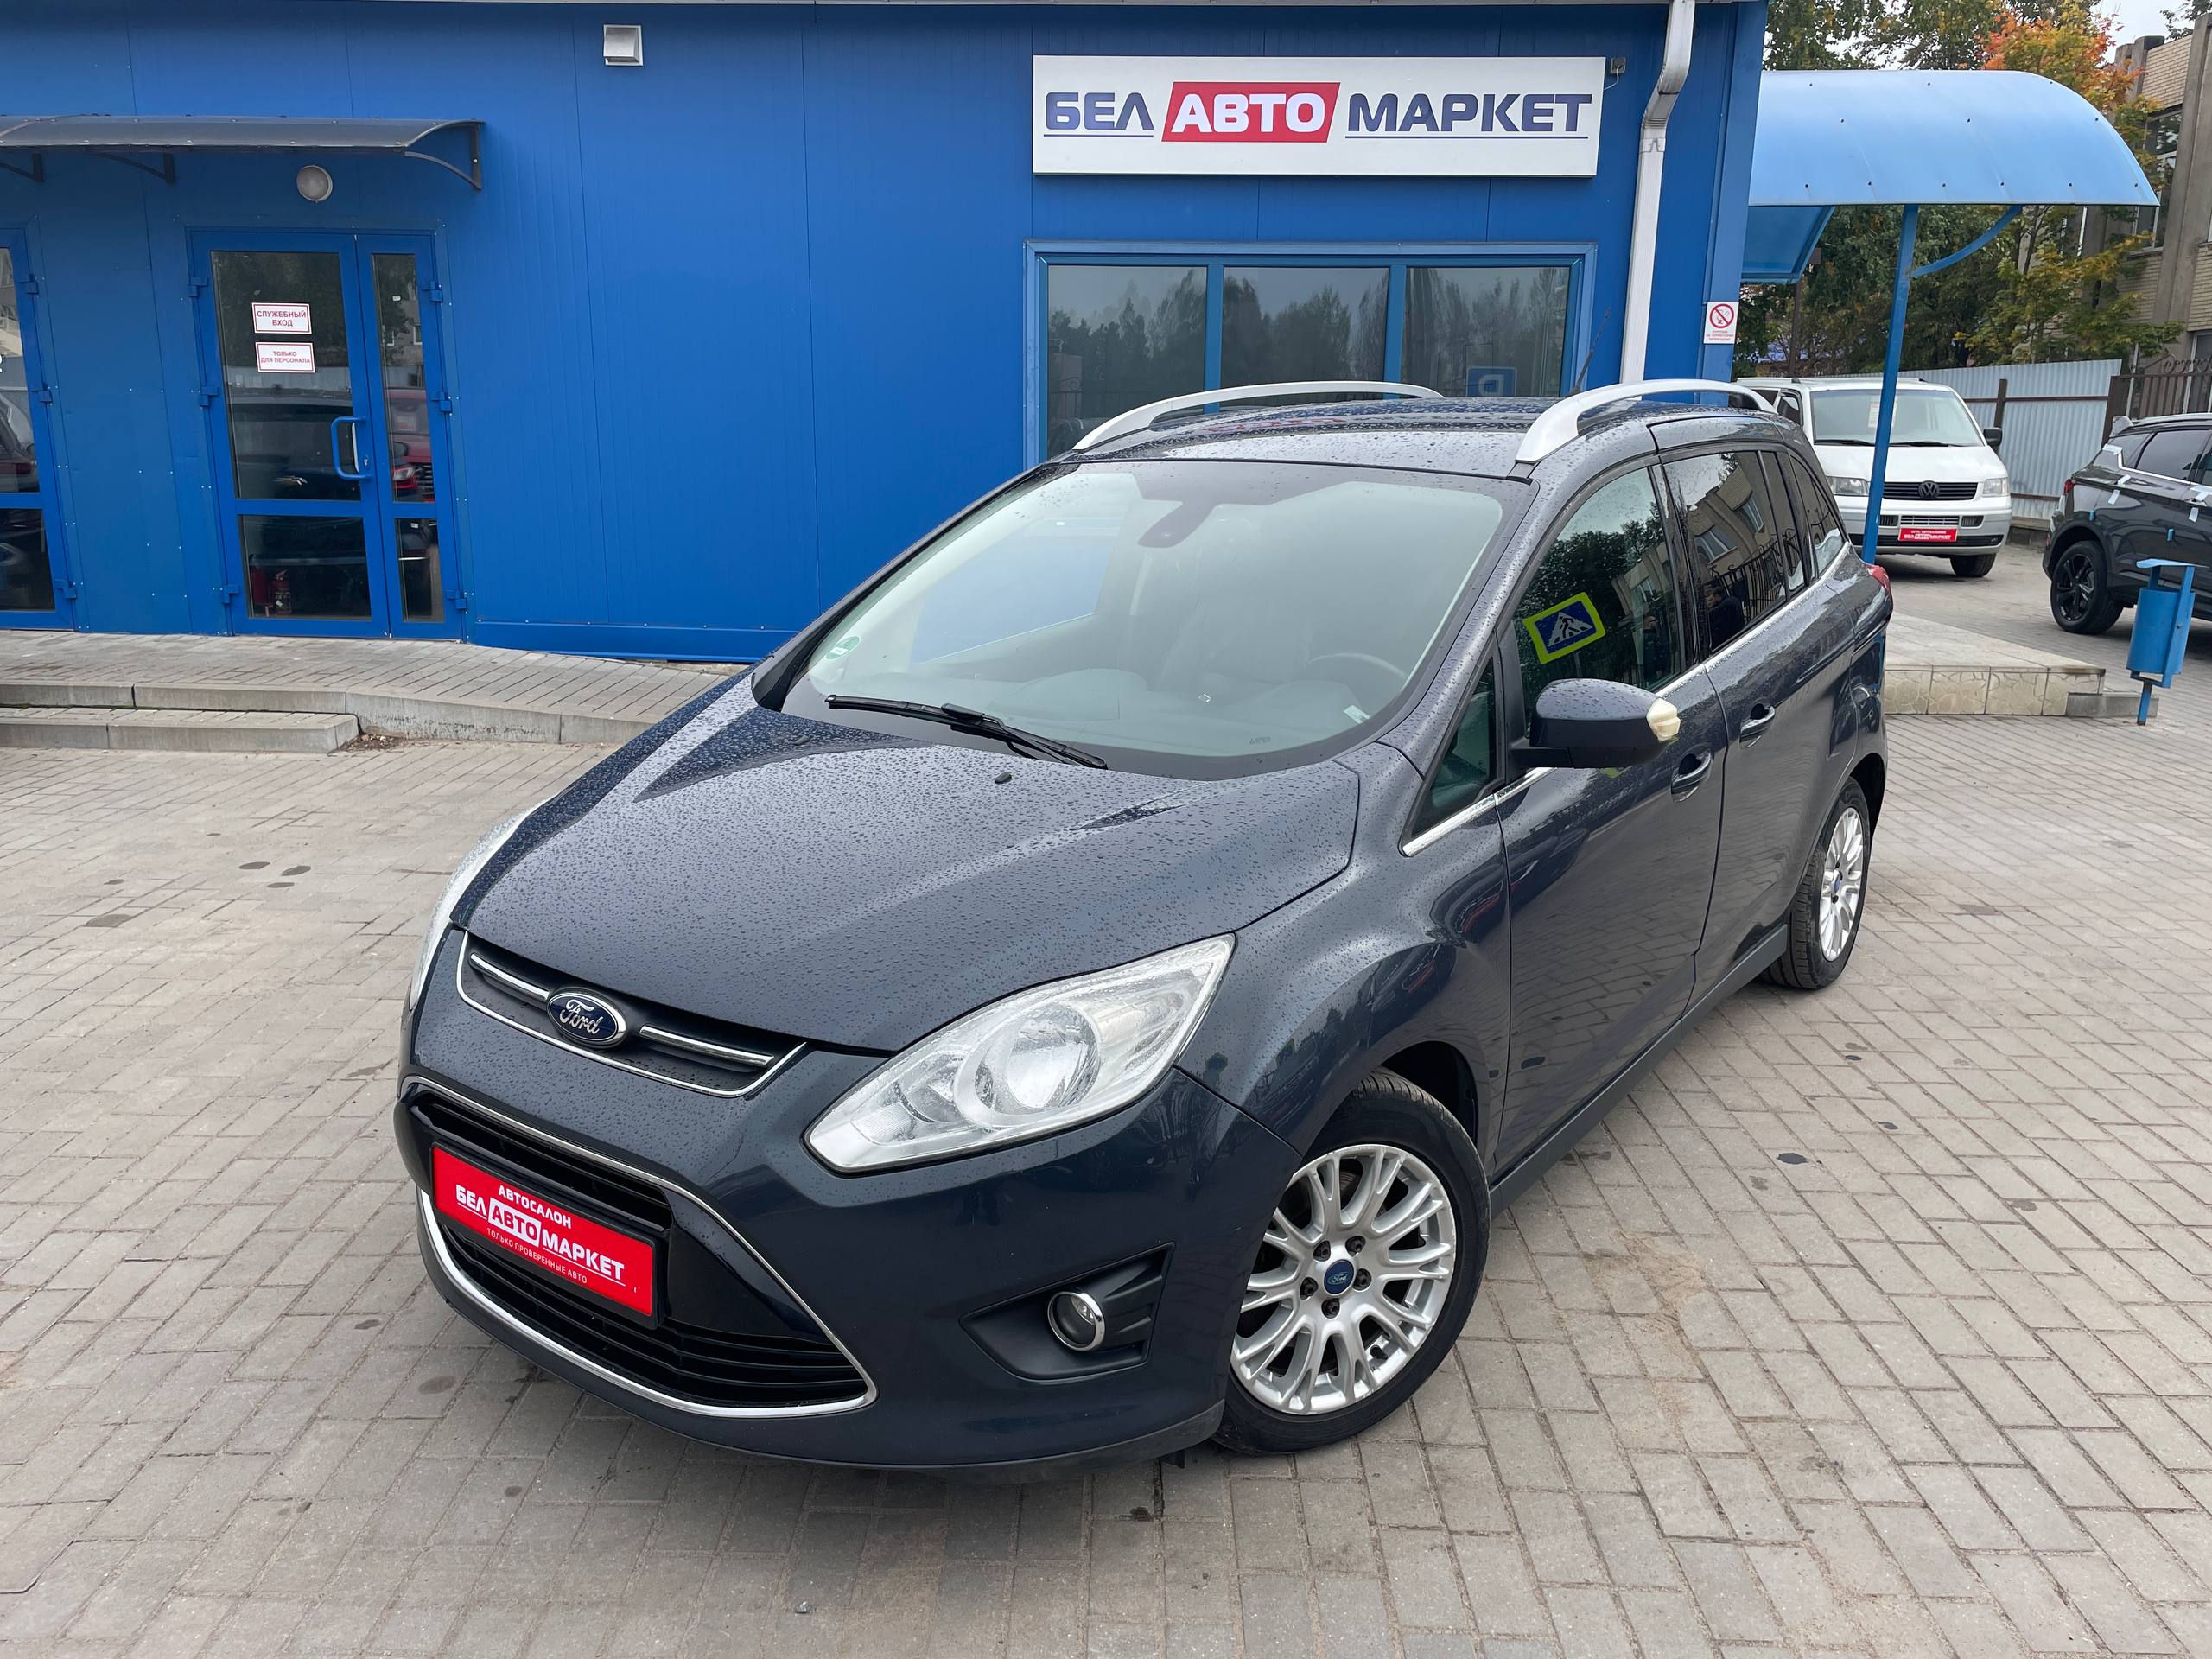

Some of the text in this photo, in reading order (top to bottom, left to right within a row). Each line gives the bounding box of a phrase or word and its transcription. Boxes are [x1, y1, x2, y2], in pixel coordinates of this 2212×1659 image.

[1045, 92, 1592, 133] БЕЛ АВТО МАРКЕТ
[559, 999, 604, 1034] Ford
[498, 1185, 572, 1230] АВТОСАЛОН
[455, 1184, 625, 1281] БЕЛ АВТО МАРКЕТ
[486, 1227, 588, 1285] ТОЛЬКО ПРОВЕРЕННЫЕ АВТО
